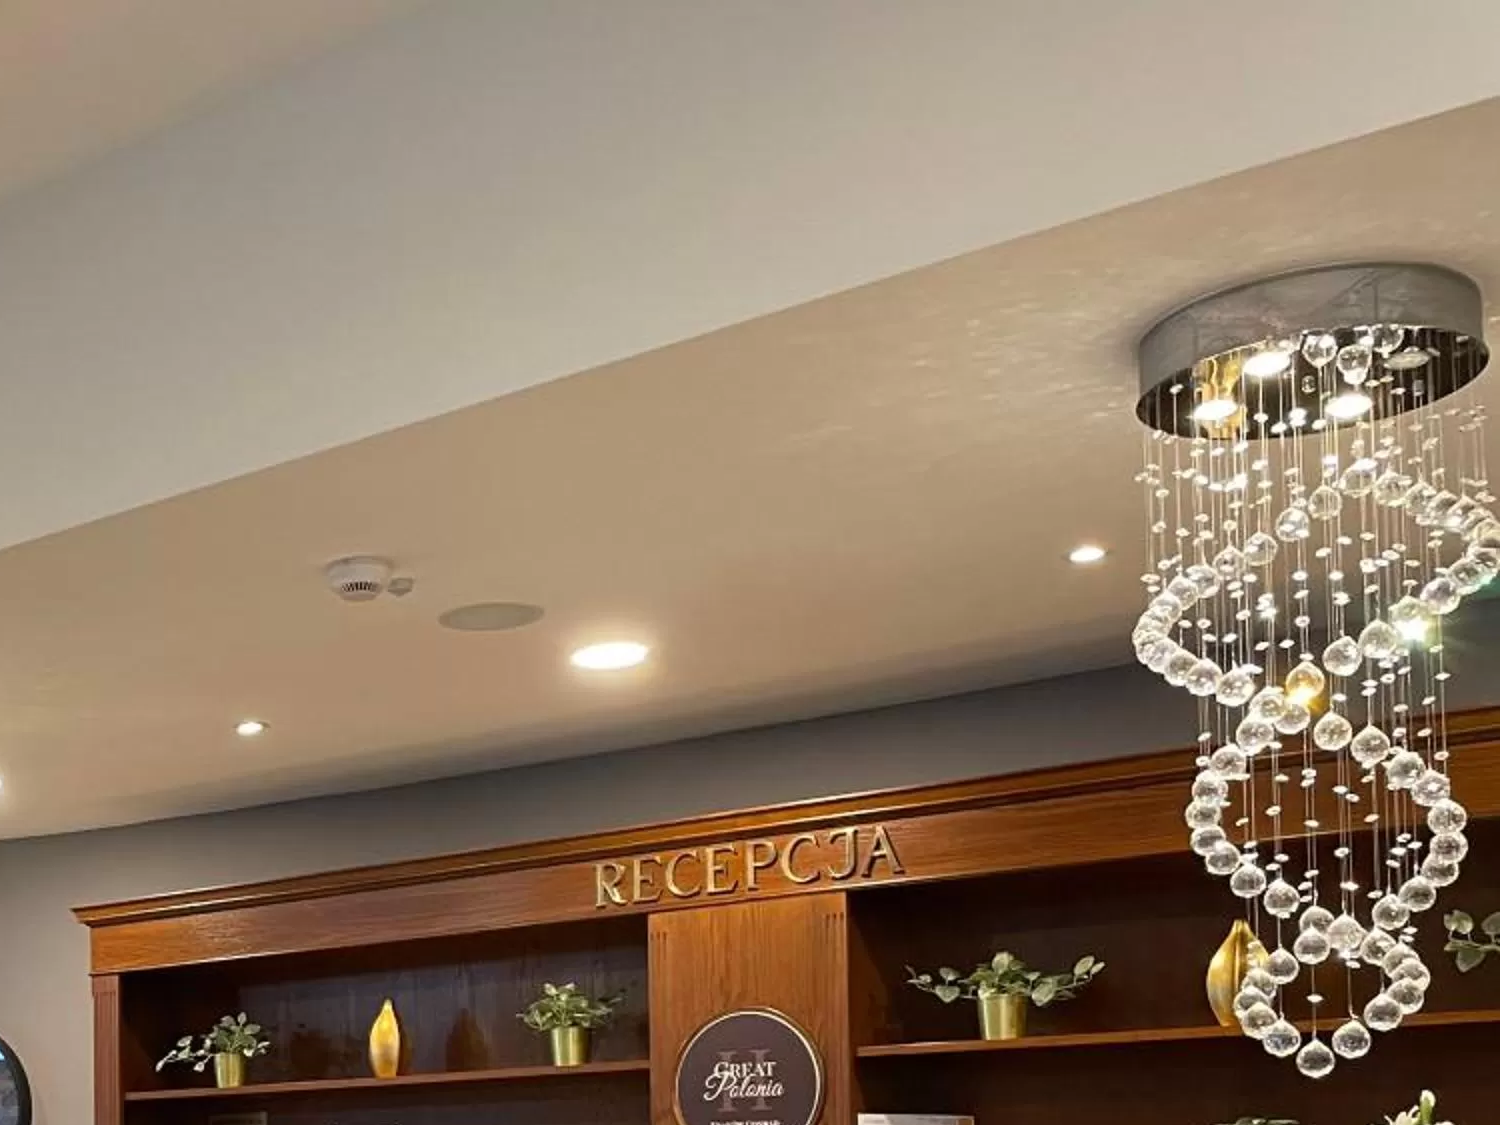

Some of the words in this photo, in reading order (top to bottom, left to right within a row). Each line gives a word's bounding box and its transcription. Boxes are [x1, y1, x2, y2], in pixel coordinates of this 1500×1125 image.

[594, 825, 906, 909] RECEPCJA
[713, 1061, 777, 1078] GREAT
[703, 1071, 784, 1101] Polonia
